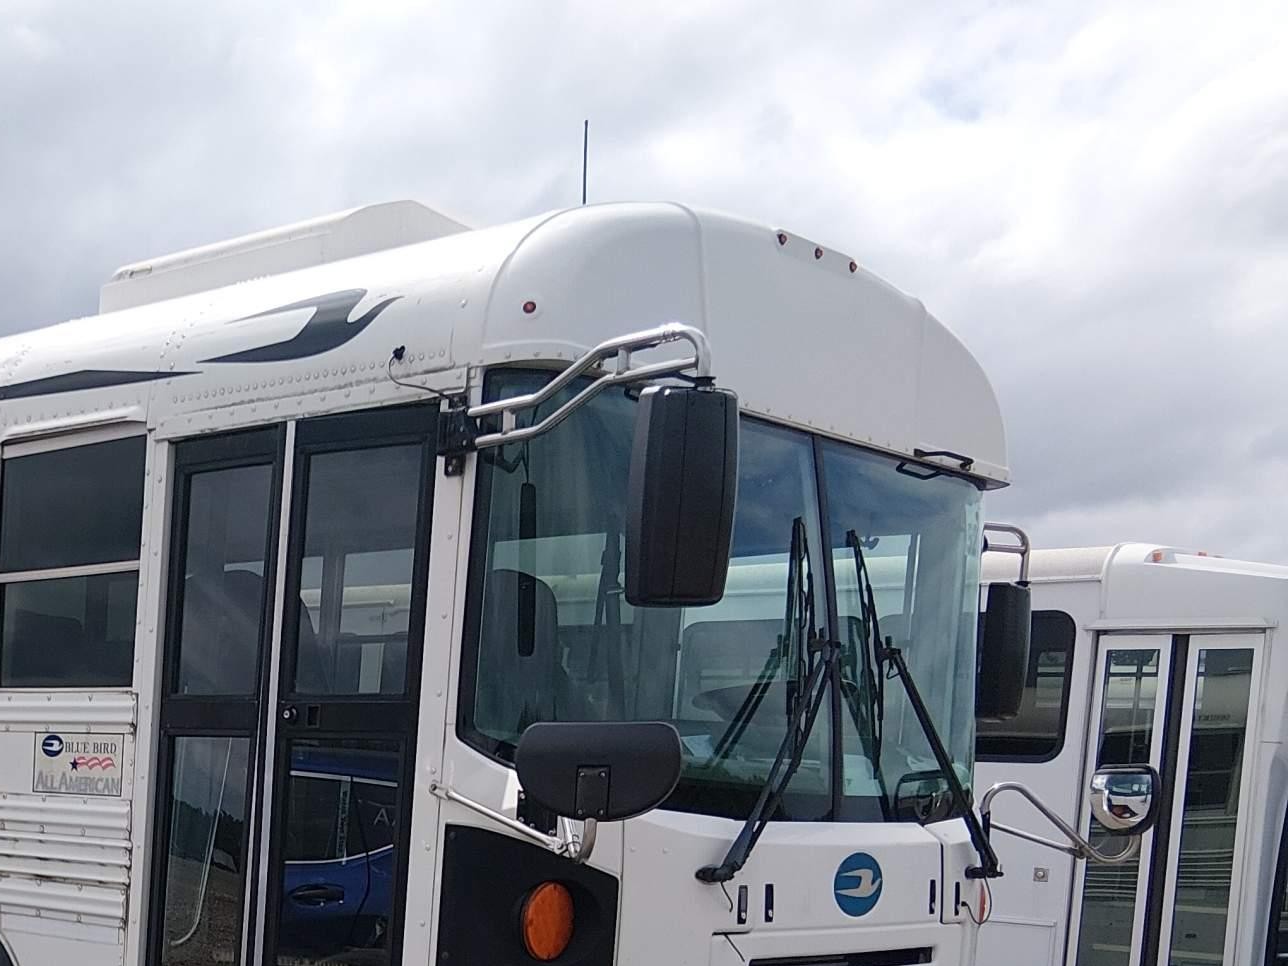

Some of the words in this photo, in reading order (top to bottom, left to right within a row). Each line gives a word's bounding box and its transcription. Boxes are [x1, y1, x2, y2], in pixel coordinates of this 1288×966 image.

[65, 741, 90, 754] BLUE
[93, 742, 117, 756] BIRD
[35, 769, 58, 791] ALL
[58, 771, 120, 795] AMERICAN
